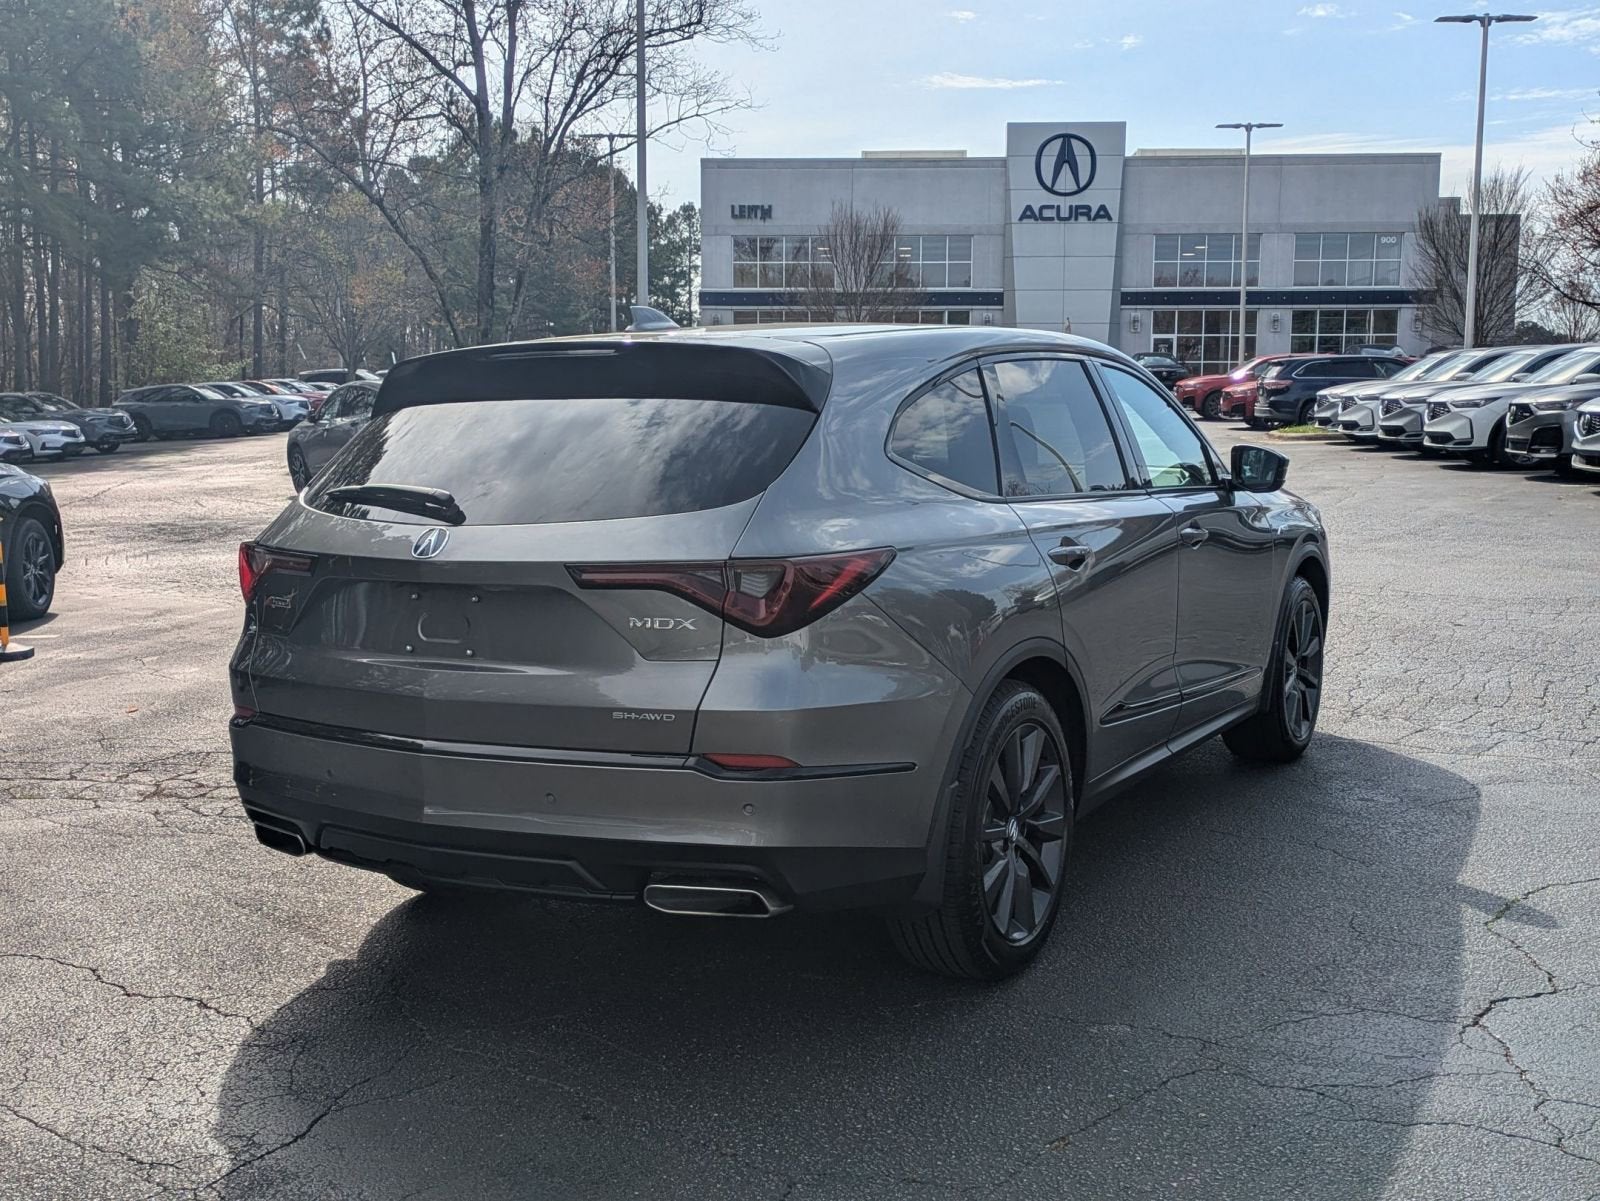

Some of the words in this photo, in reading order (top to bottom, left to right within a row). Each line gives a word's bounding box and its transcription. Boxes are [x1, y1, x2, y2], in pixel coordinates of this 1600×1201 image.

[731, 204, 772, 220] LEITH
[1018, 204, 1113, 221] ACURA
[1380, 236, 1397, 244] 900
[629, 617, 697, 630] MDX
[612, 711, 675, 721] SH-AWD
